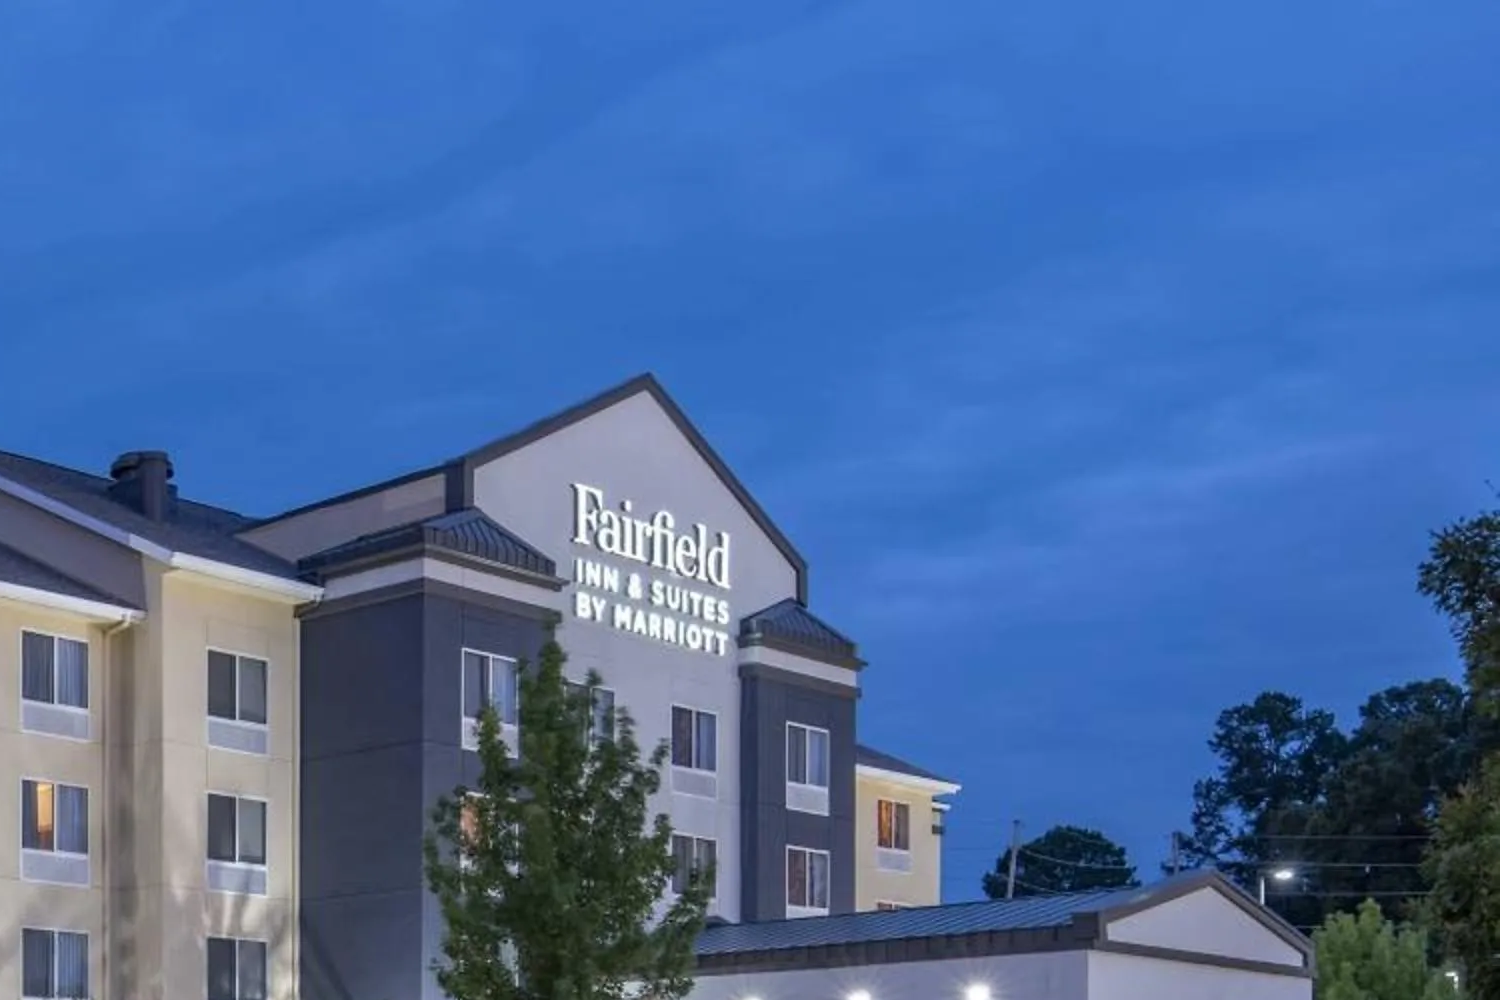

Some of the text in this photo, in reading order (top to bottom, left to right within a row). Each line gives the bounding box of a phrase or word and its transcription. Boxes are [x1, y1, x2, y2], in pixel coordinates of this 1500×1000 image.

[572, 483, 731, 589] Fairfield
[575, 591, 729, 657] BY MARRIOTT
[576, 558, 730, 625] INN & SUITES
